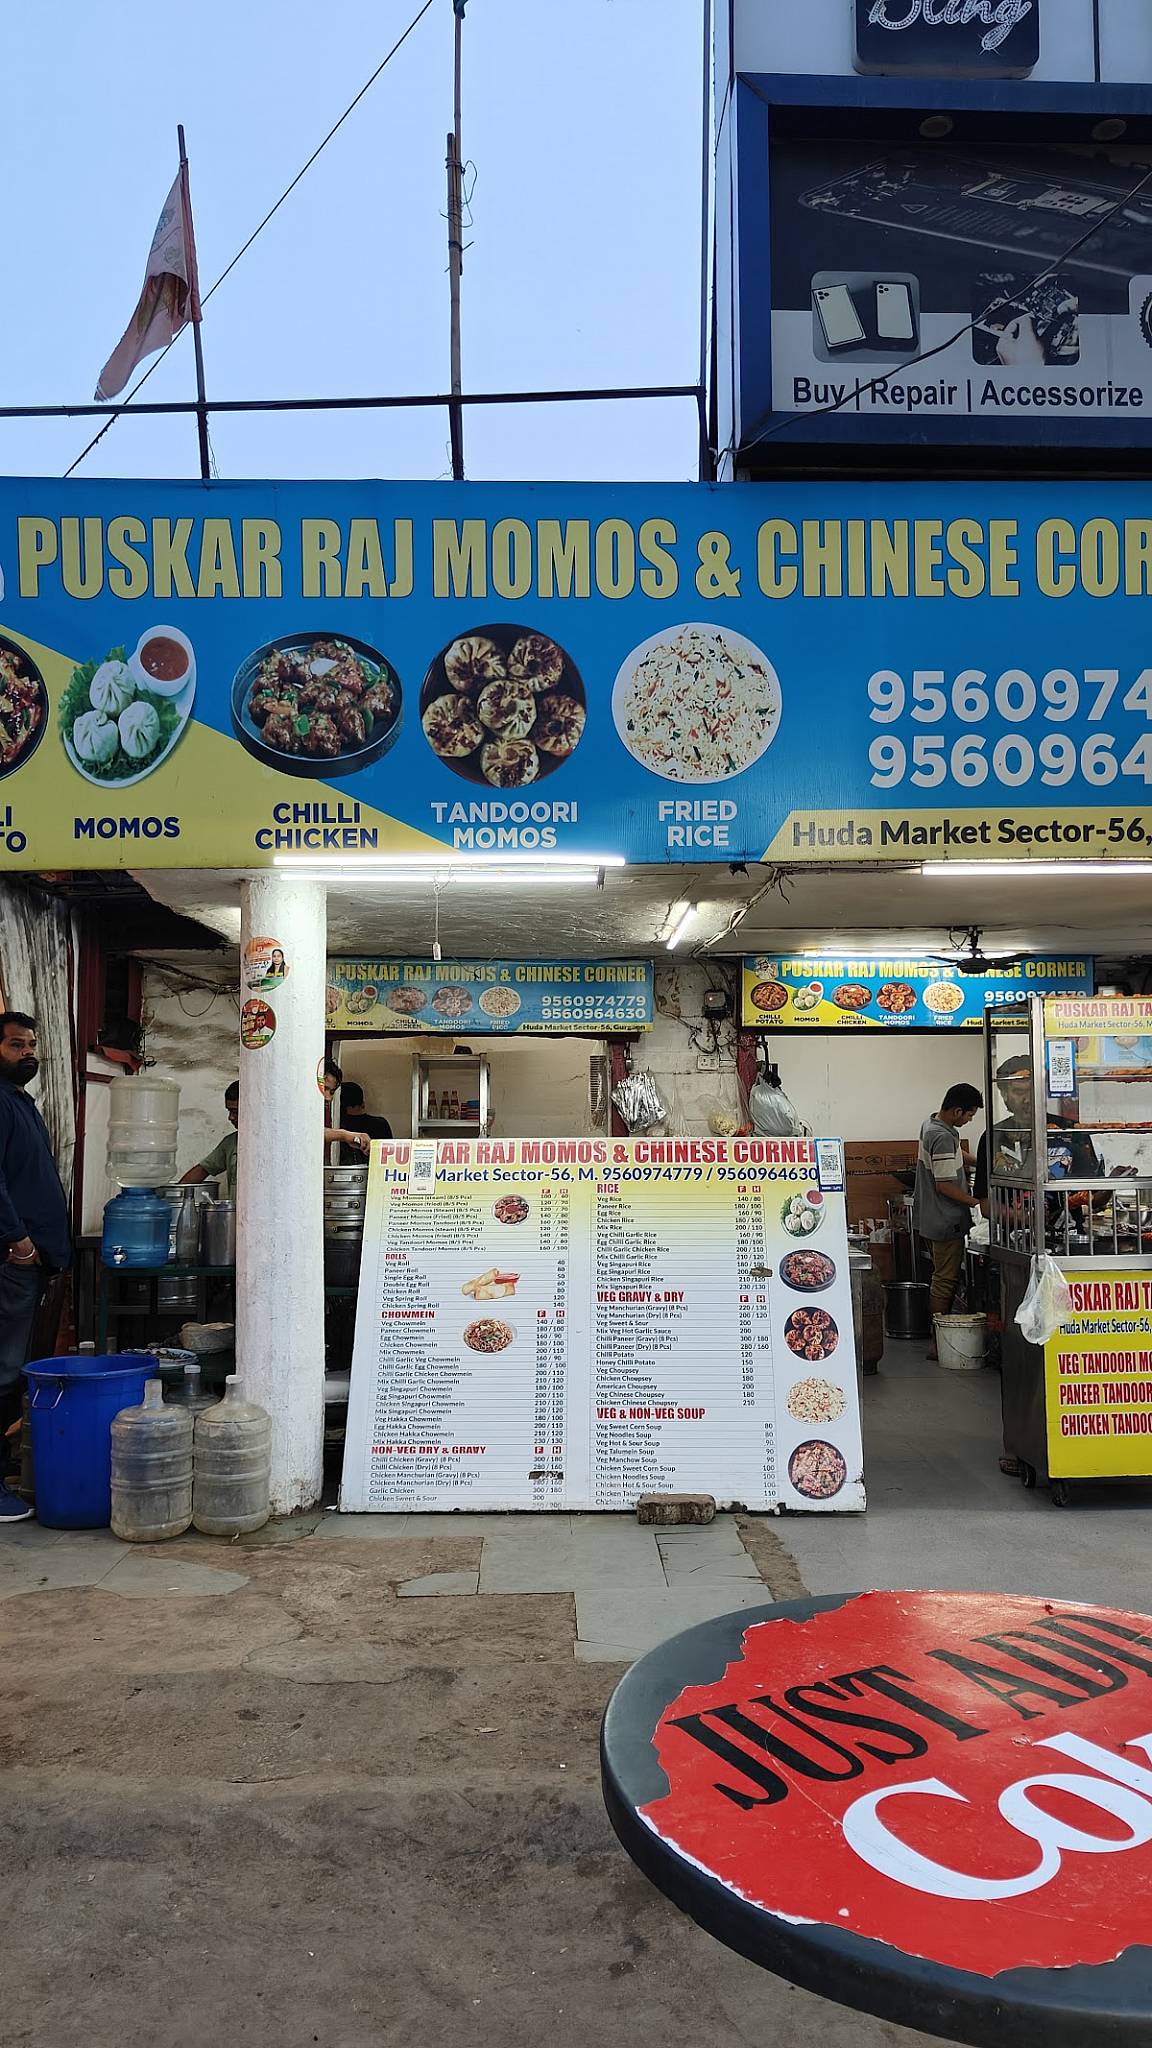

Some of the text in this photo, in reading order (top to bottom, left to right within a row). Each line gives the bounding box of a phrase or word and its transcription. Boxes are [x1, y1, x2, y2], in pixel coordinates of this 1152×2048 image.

[792, 377, 846, 406] Buy
[871, 379, 957, 411] Repair
[980, 380, 1143, 407] Accessorize
[17, 516, 283, 599] PUSKAR
[301, 518, 414, 599] RAJ
[432, 518, 680, 600] MOMOS
[695, 531, 741, 599] &
[756, 518, 1020, 599] CHINESE
[272, 802, 361, 825] CHILLI
[430, 801, 578, 824] TANDOORI
[658, 800, 738, 822] FRIED
[74, 817, 180, 838] MOMOS
[453, 827, 557, 849] MOMOS
[667, 826, 729, 847] RICE
[793, 816, 1151, 847] Huda Market Sector-56,
[255, 828, 378, 849] CHICKEN
[335, 964, 646, 983] PUSKAR RAJ MOMOS & CHINESE CORNER
[781, 960, 844, 978] PUSKAR
[847, 961, 876, 978] RAJ
[1025, 961, 1086, 978] CORNER
[542, 995, 646, 1006] 9560974779
[1055, 1003, 1107, 1017] PUSKAR
[1112, 1003, 1134, 1017] RAJ
[541, 1008, 646, 1019] 9560964630
[1080, 1020, 1106, 1028] Market
[381, 1142, 470, 1164] PUAR
[477, 1142, 515, 1164] RAJ
[521, 1141, 607, 1164] MOMOS
[612, 1144, 629, 1163] &
[634, 1141, 729, 1163] CHINESE
[493, 1168, 575, 1184] Sector-56,
[578, 1168, 598, 1182] M.
[603, 1166, 702, 1182] 9560974779
[717, 1166, 818, 1181] 9560964630
[597, 1183, 619, 1193] RICE
[597, 1291, 616, 1302] VEG
[618, 1291, 652, 1302] GRAVY
[654, 1292, 661, 1302] &
[664, 1291, 684, 1302] DRY
[1114, 1282, 1140, 1310] RAJ
[1082, 1318, 1110, 1333] Market
[1058, 1353, 1079, 1374] VEG
[1082, 1352, 1136, 1374] TANDOORI
[1060, 1384, 1100, 1405] PANEER
[597, 1408, 705, 1419] VEG & NON-VEG SOUP
[1061, 1413, 1110, 1436] CHICKEN
[371, 1446, 416, 1454] NON-VEG
[420, 1446, 440, 1454] DRY
[452, 1446, 486, 1454] GRAVY
[664, 1664, 989, 1811] JUST
